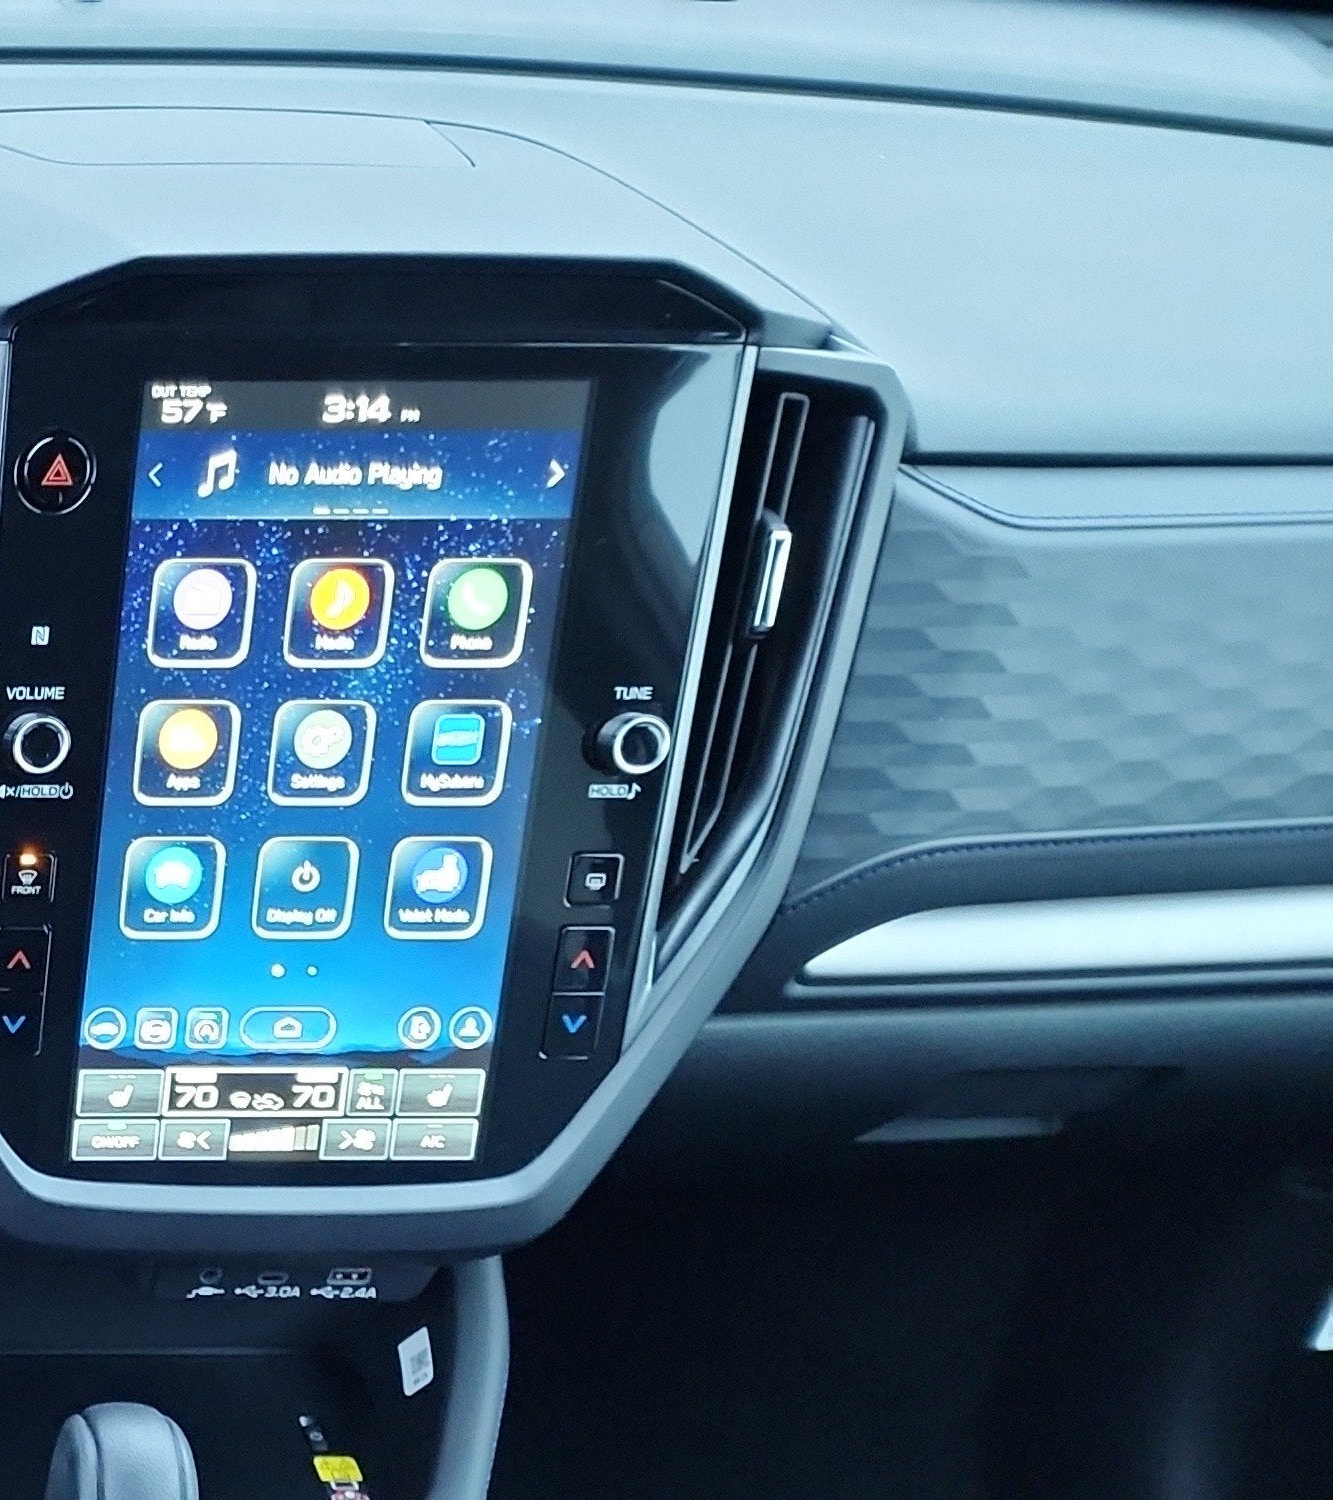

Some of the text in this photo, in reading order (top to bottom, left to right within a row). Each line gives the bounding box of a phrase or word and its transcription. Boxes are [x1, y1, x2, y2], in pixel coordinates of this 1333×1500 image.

[321, 394, 392, 424] 3:14
[268, 460, 444, 491] No Audio Playing
[6, 686, 66, 701] VOLUME
[614, 686, 654, 700] TUNE
[589, 784, 628, 798] HOLD
[11, 885, 41, 895] FRONT
[173, 1084, 220, 1109] 70
[291, 1084, 336, 1109] 70
